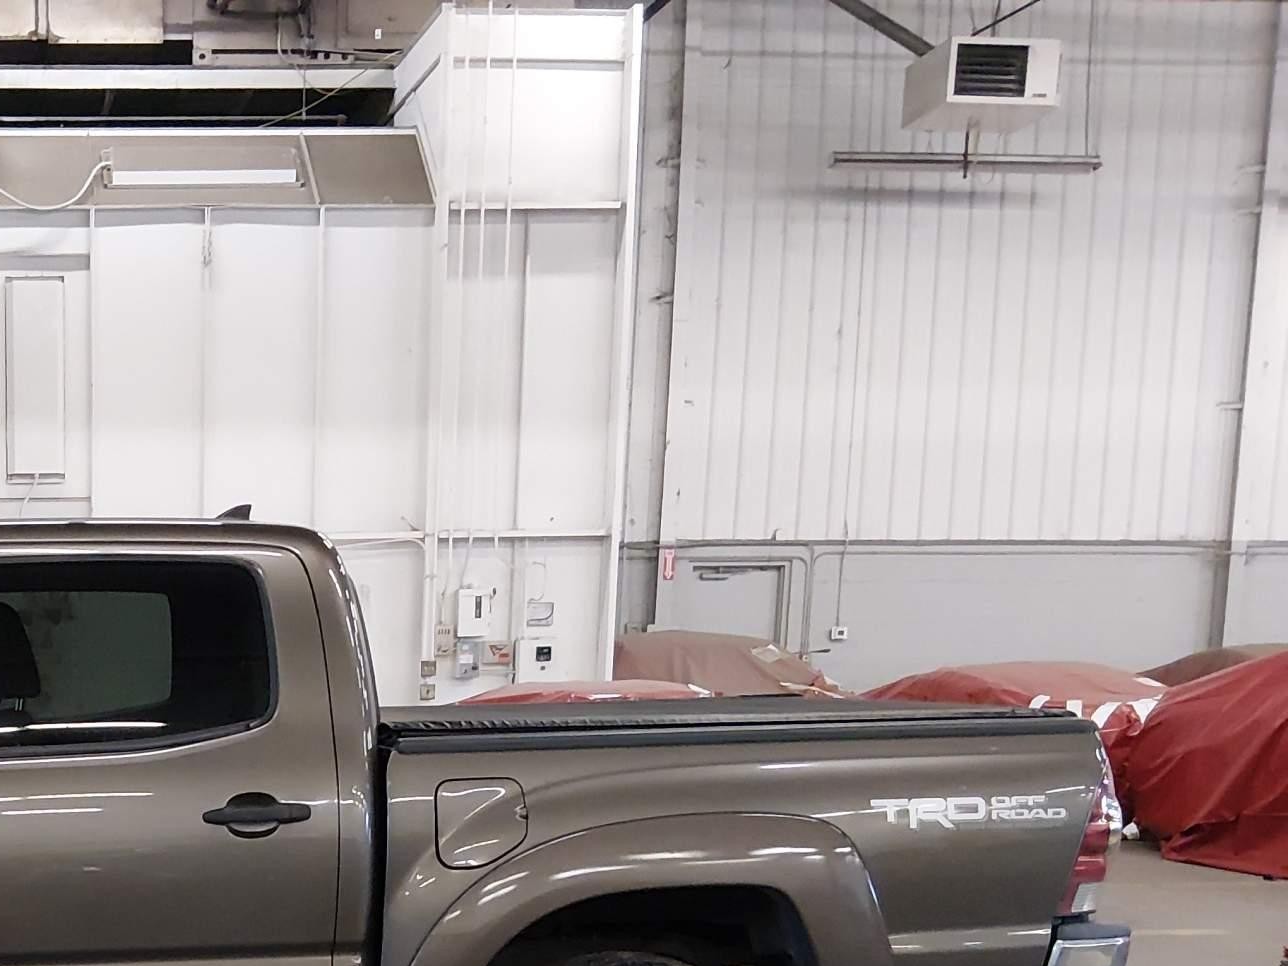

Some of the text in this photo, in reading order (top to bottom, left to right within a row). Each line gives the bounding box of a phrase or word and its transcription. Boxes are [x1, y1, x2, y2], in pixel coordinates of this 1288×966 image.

[991, 795, 1045, 806] OFF
[870, 797, 986, 829] TRD
[991, 808, 1066, 819] ROAD
